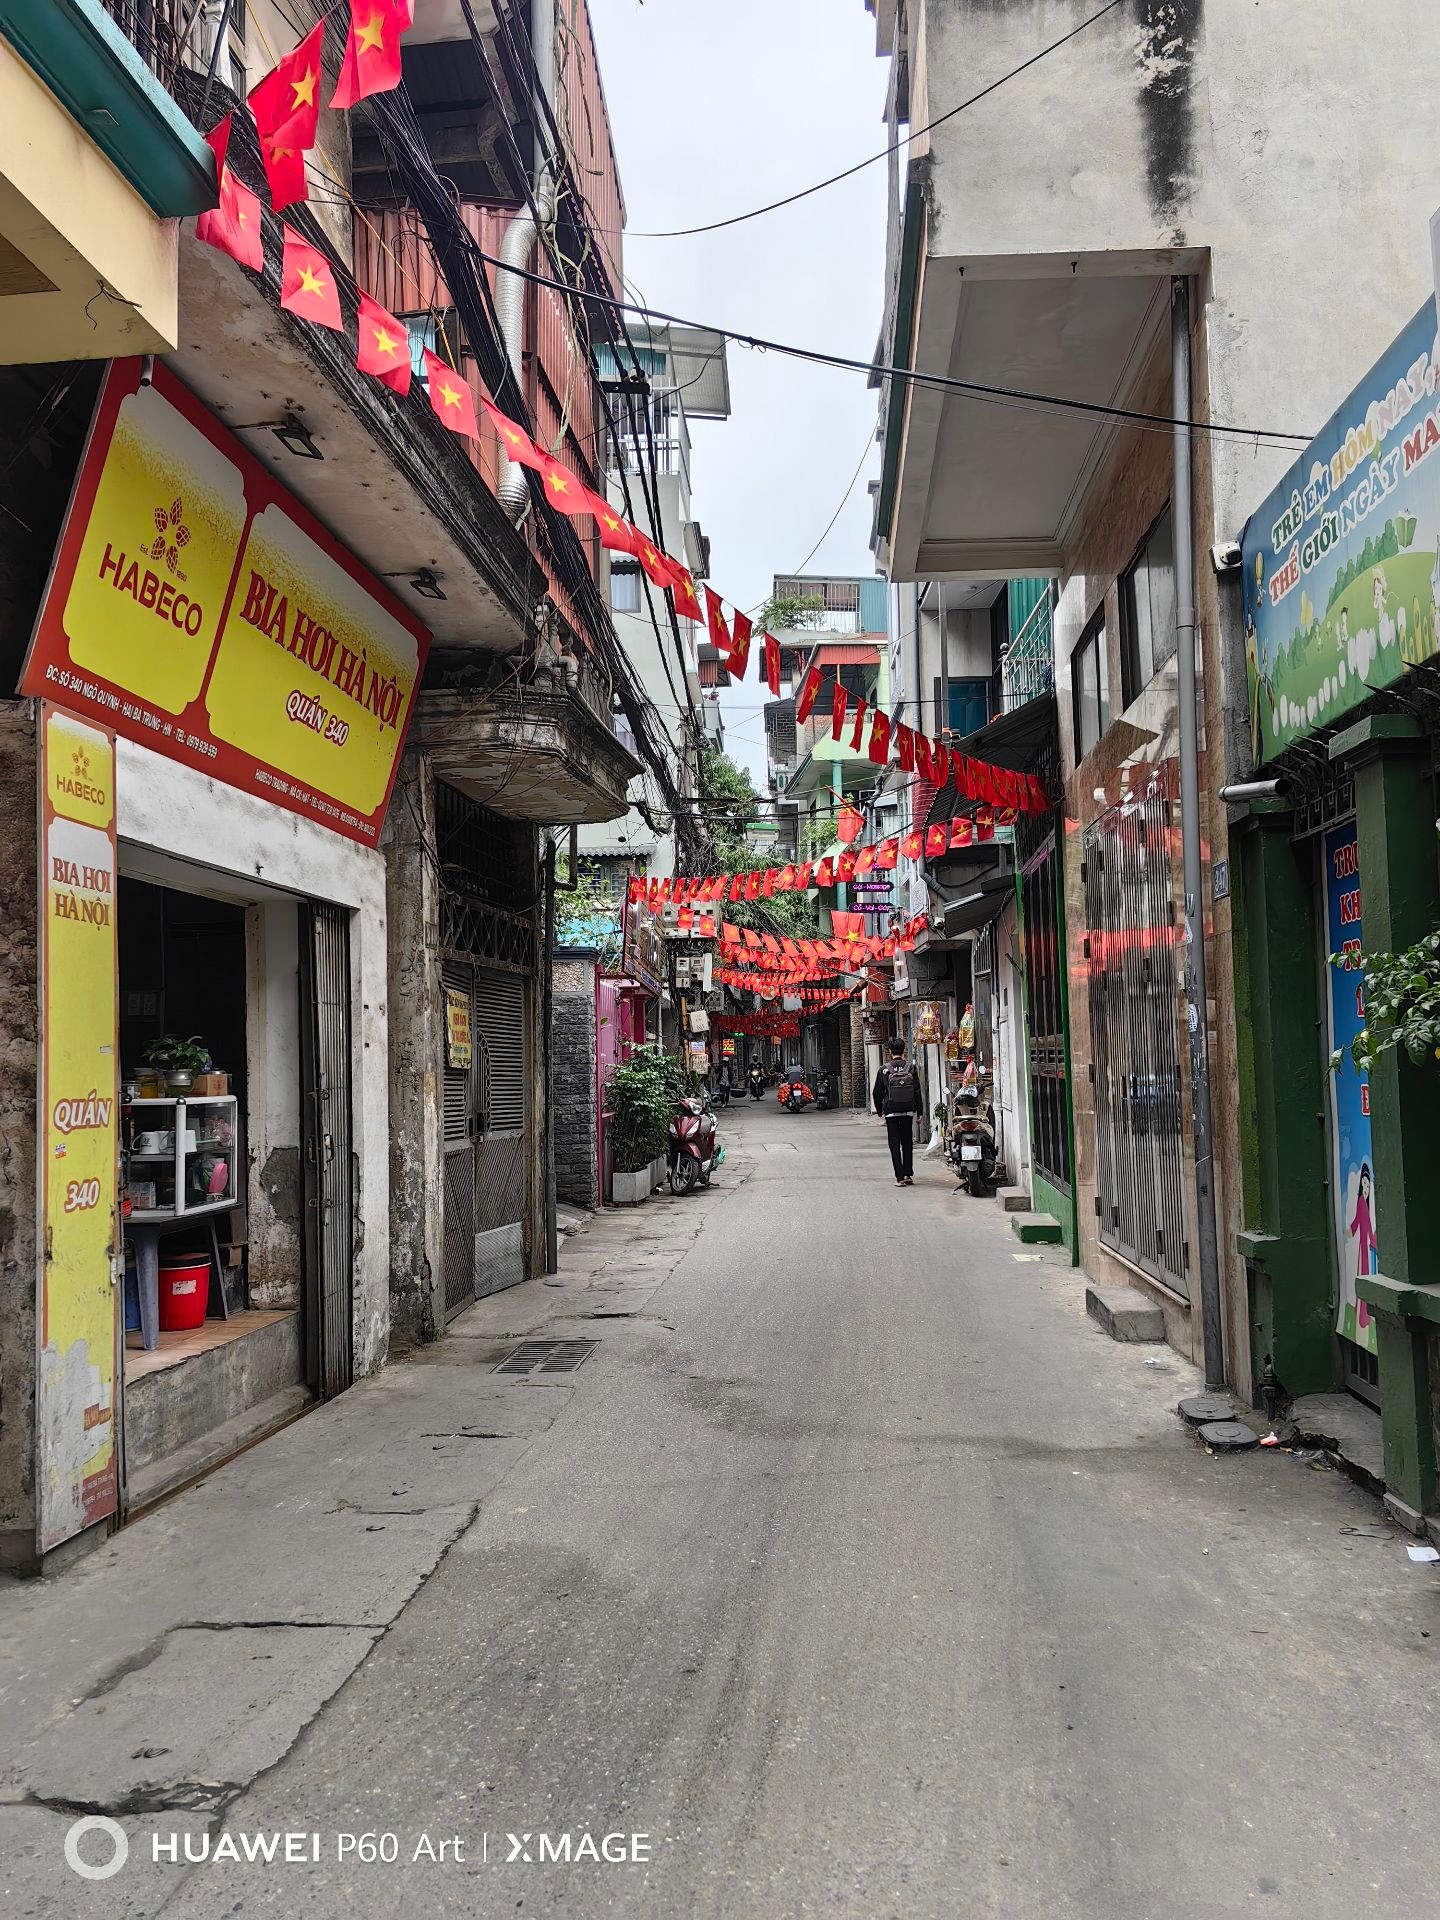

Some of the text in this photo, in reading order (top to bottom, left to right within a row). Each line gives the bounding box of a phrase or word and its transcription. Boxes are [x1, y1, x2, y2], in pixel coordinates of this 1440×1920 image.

[1269, 405, 1440, 605] THẾ GIỚI NGÀY MA
[1272, 492, 1302, 551] TRẺ
[1304, 468, 1329, 519] EM
[1332, 420, 1375, 487] HÔM
[99, 542, 203, 637] HABECO
[240, 569, 404, 732] BIA HƠI HÀ NỘI
[46, 664, 60, 682] ĐC:
[59, 670, 72, 687] SỐ
[69, 676, 83, 693] 340
[121, 701, 134, 718] HAI
[133, 706, 143, 722] BÀ
[162, 722, 173, 736] HN
[286, 690, 349, 746] QUÁN 340
[56, 774, 106, 806] HABECO
[52, 857, 112, 894] BIA HƠI
[1334, 841, 1360, 879] TR
[54, 890, 111, 932] HÀ NỘI
[1340, 890, 1361, 925] KH
[54, 1088, 112, 1135] QUÁN
[64, 1177, 100, 1213] 340
